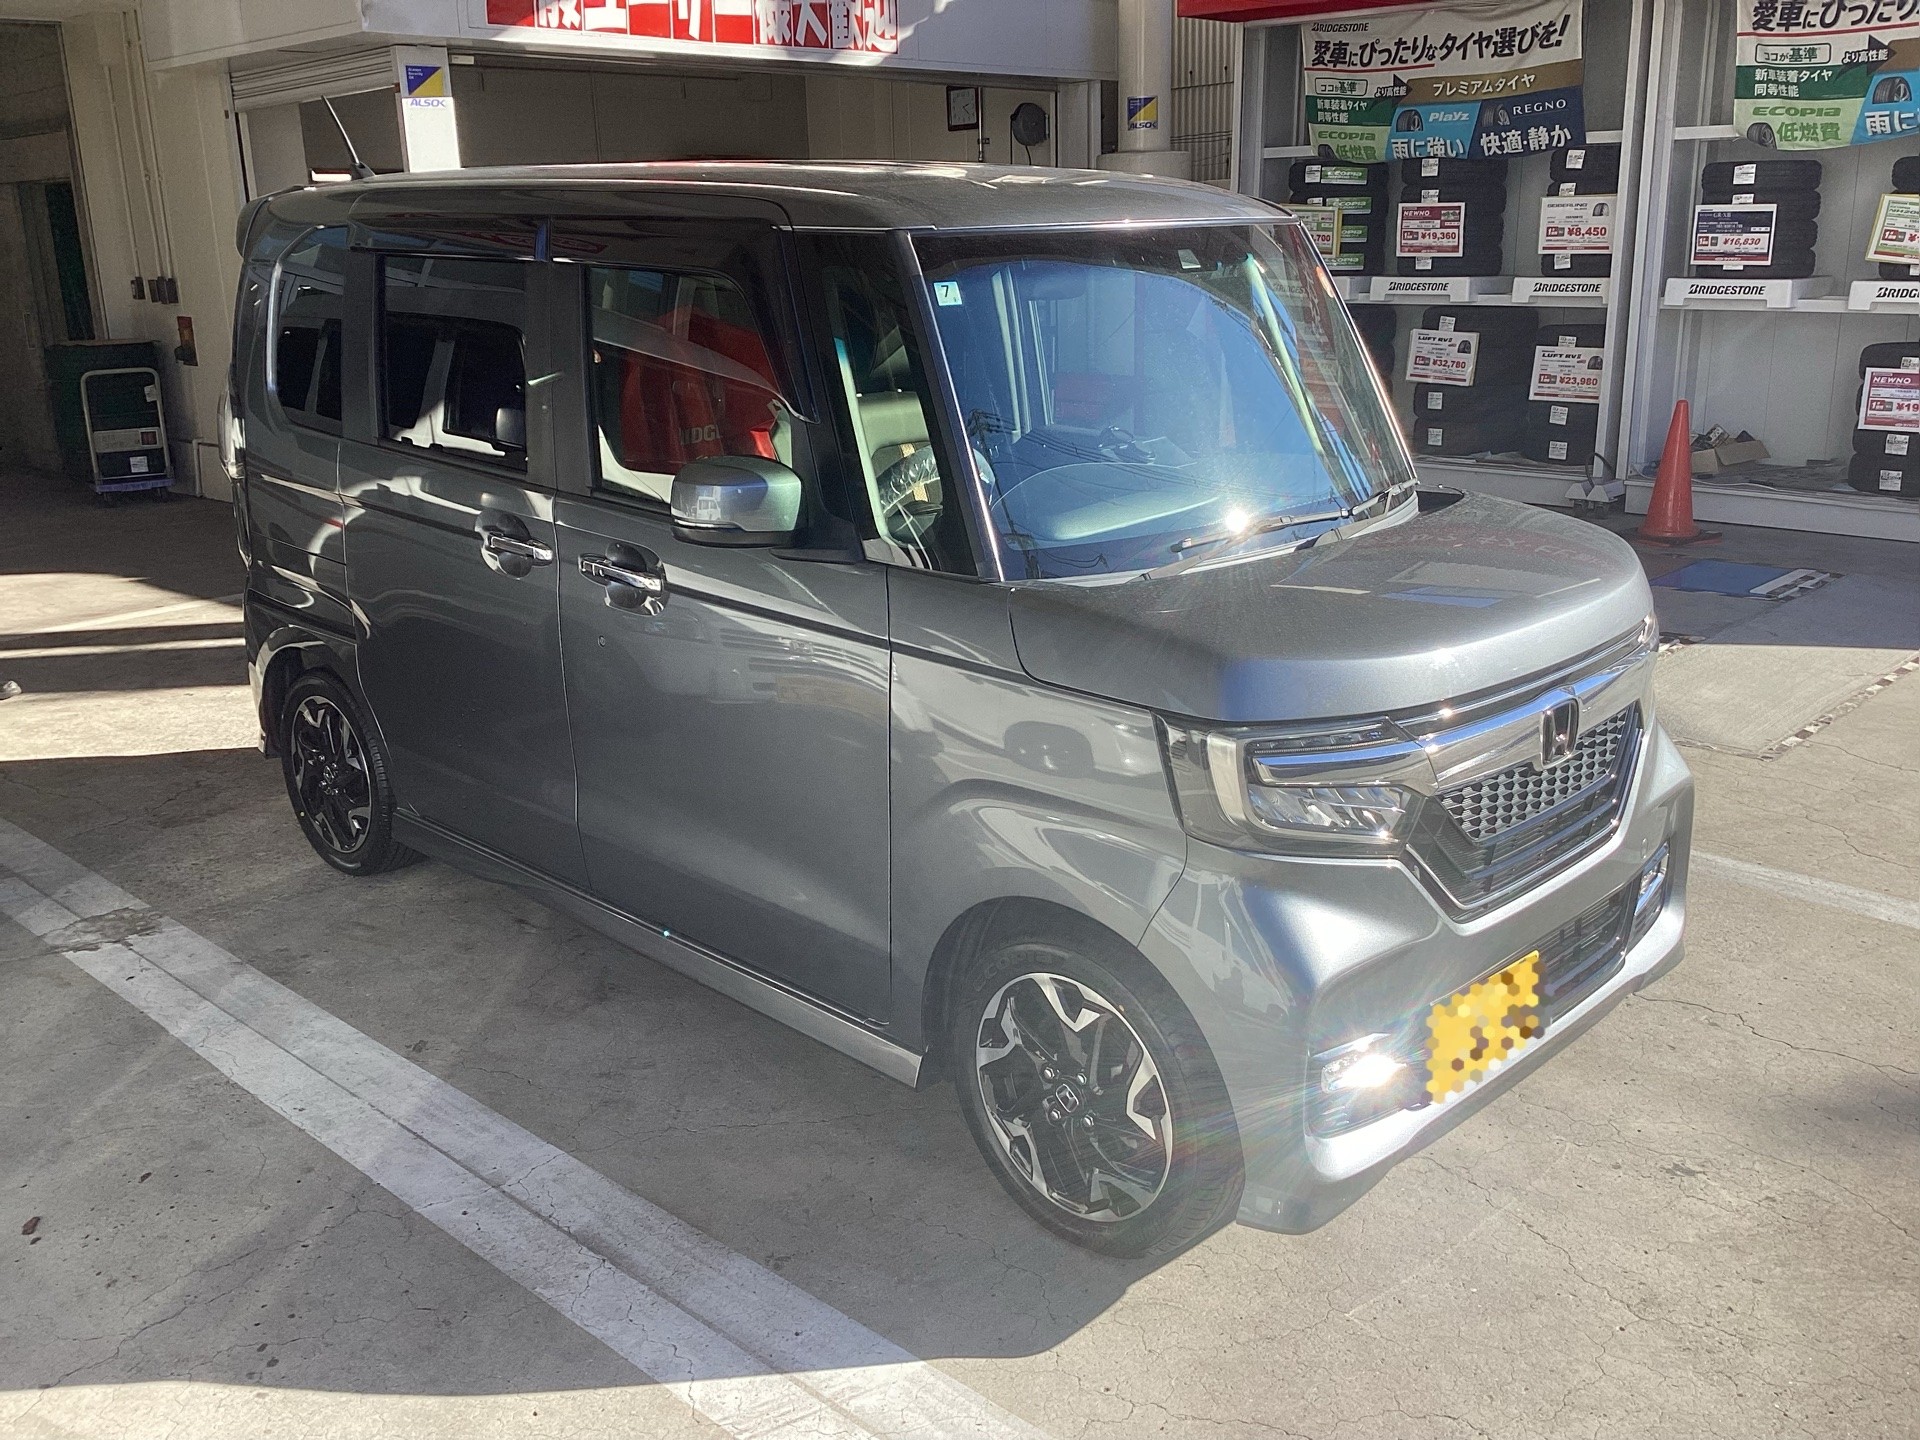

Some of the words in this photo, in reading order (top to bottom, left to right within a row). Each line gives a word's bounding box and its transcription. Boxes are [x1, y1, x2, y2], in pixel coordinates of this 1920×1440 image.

[1311, 22, 1369, 33] BRIDGESTONE
[1764, 47, 1818, 62] ココが基準
[1842, 50, 1888, 63] より高性能
[1754, 69, 1833, 82] 新車装着タイヤ
[1321, 81, 1357, 93] ココが基準
[1433, 74, 1536, 96] プレミアムタイヤ
[1754, 84, 1799, 97] 同等性能
[1375, 86, 1407, 97] より高性能
[410, 99, 447, 108] ALSOK
[1317, 99, 1368, 111] 新車装着タイヤ
[1512, 99, 1567, 116] REGNO
[1317, 112, 1349, 123] 同等性能
[1777, 122, 1842, 142] 低燃費
[1480, 124, 1572, 156] 快適・静か
[1336, 144, 1378, 160] 低燃費
[1391, 137, 1464, 160] 雨に強い
[1421, 232, 1457, 241] ¥19,360
[1567, 227, 1607, 237] ¥8,450
[1723, 238, 1761, 247] ¥16,830
[941, 285, 948, 297] 7
[1388, 282, 1449, 292] BRIDGESTONE
[1533, 282, 1602, 293] BRIDGESTONE
[1688, 284, 1766, 295] BRIDGESTONE
[1432, 358, 1466, 369] ¥32,780
[1559, 376, 1598, 386] ¥23,980
[1872, 376, 1912, 385] NEWNO
